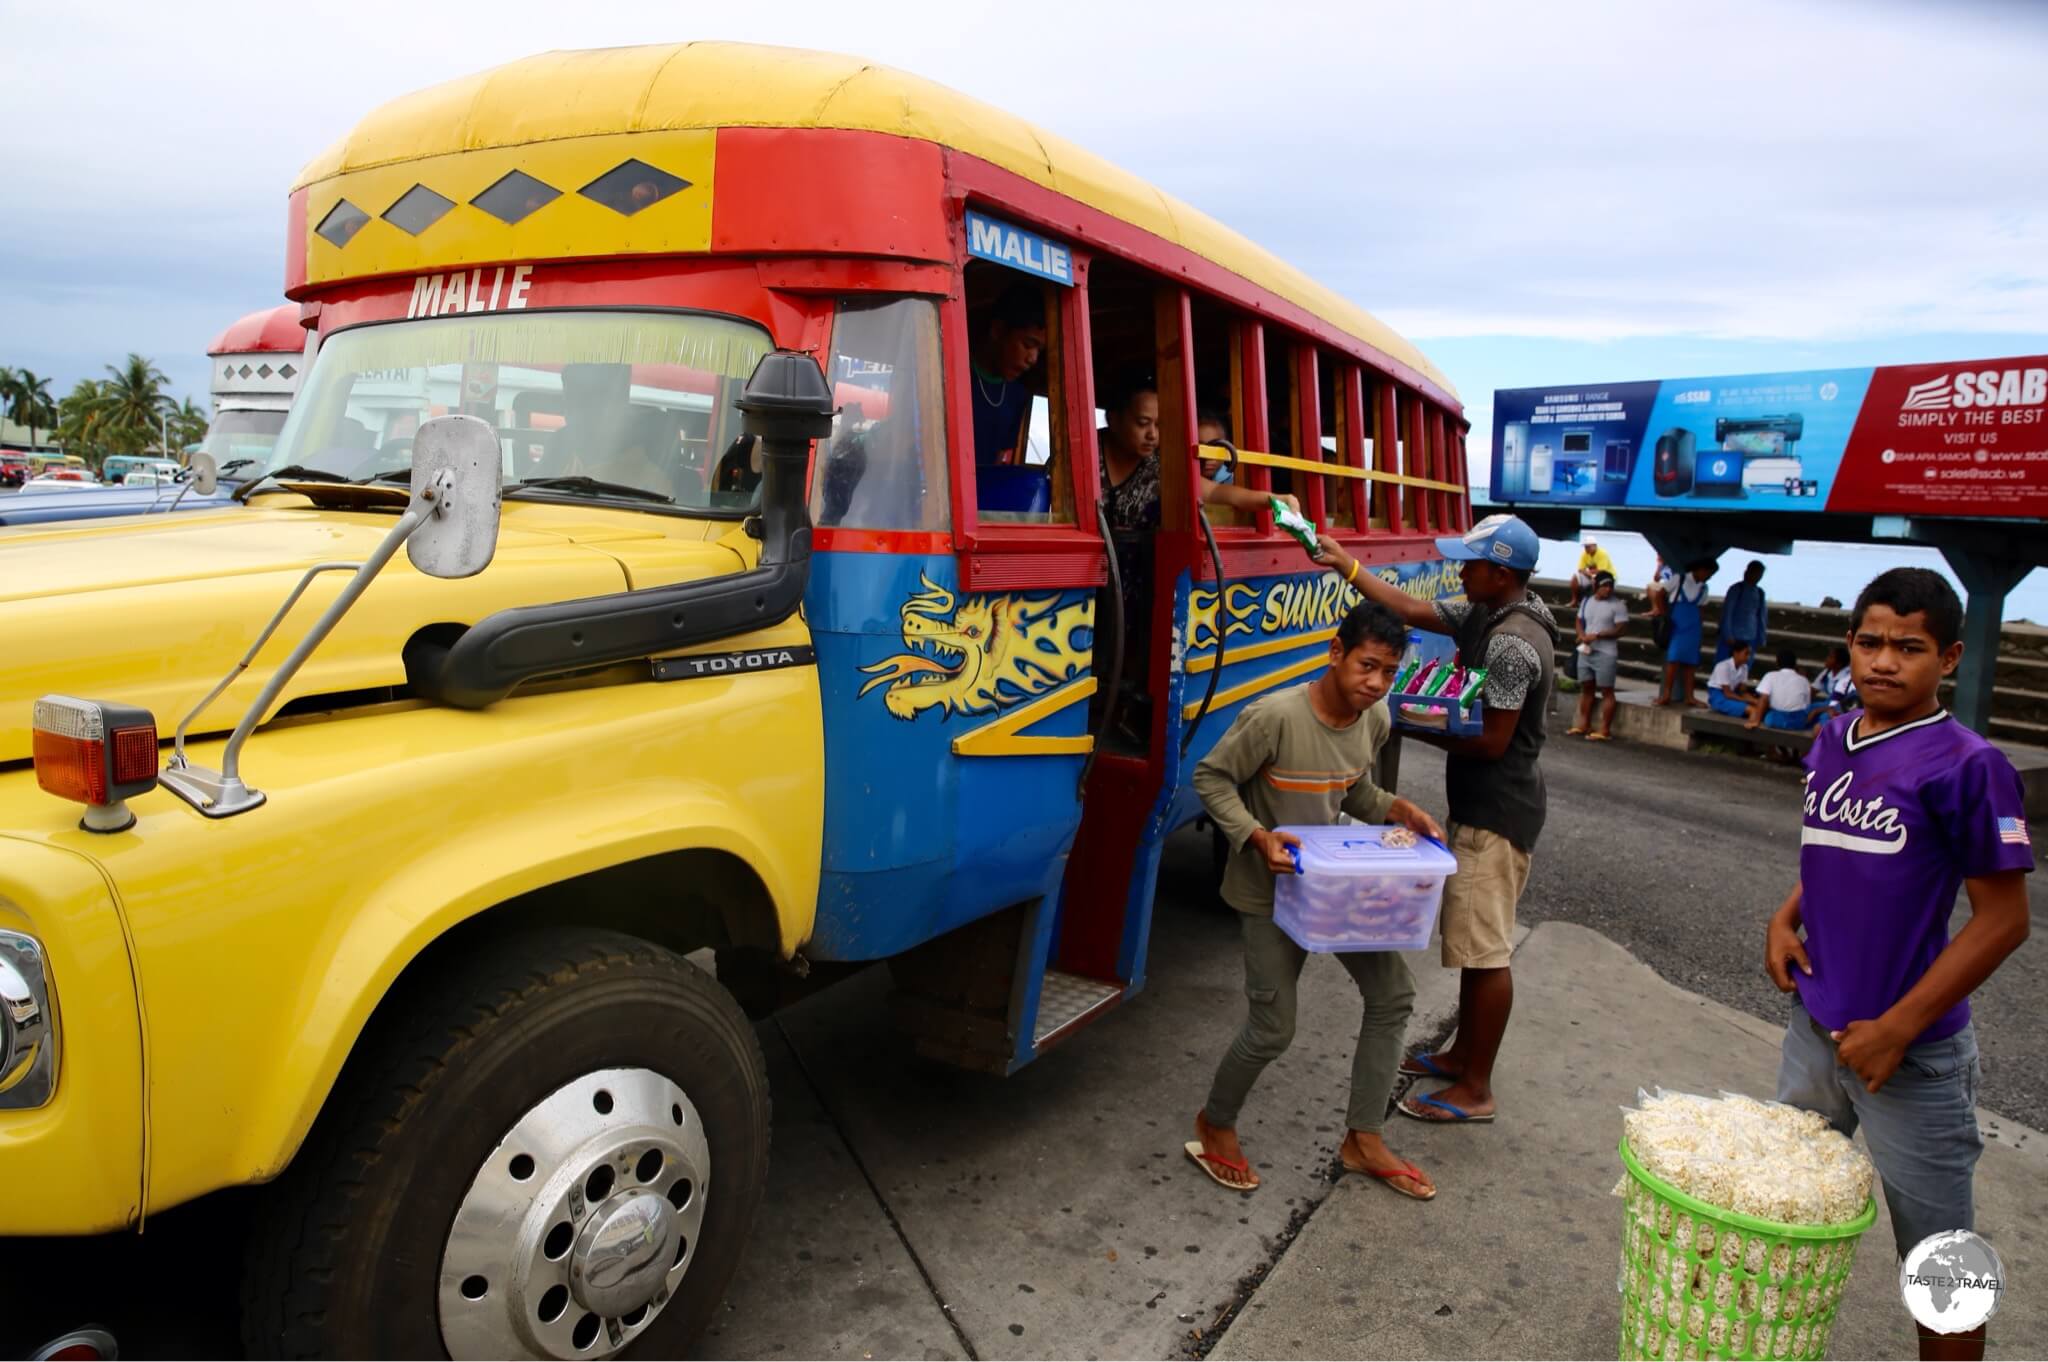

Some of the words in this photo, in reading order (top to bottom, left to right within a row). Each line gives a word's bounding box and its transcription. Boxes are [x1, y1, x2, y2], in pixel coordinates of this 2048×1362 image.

[972, 218, 1068, 280] MALIE
[407, 265, 534, 319] MALIE
[1953, 367, 2048, 409] SSAB
[1898, 412, 1959, 427] SIMPLY
[1964, 410, 1995, 425] THE
[2001, 408, 2044, 425] BEST
[1944, 433, 1975, 444] VISIT
[1980, 432, 1998, 444] US
[1261, 571, 1366, 632] SUNRIS
[690, 651, 794, 673] TOYOTA
[1820, 771, 1907, 834] Costa
